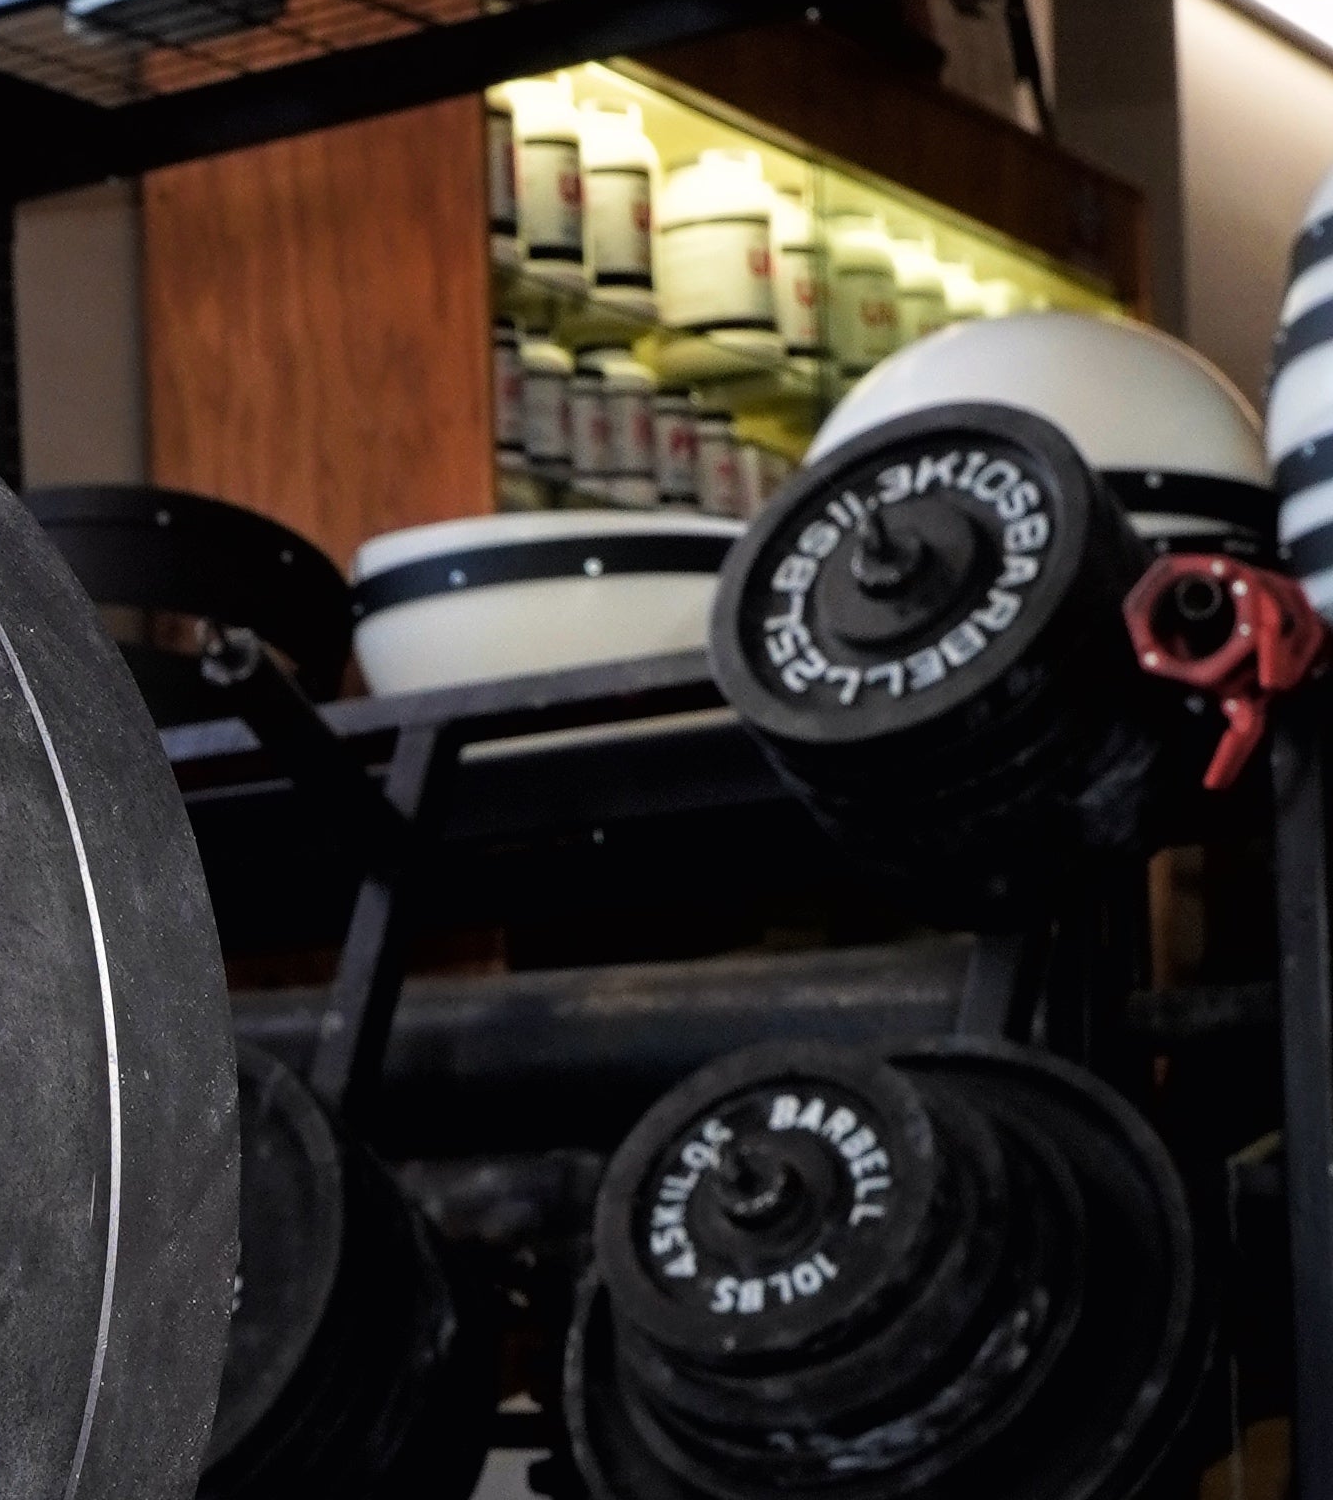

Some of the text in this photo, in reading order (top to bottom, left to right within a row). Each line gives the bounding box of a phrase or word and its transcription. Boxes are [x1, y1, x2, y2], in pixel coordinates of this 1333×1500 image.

[824, 511, 1051, 706] BARBELL
[768, 1094, 892, 1226] BARBELL
[709, 1252, 839, 1313] 10LBS
